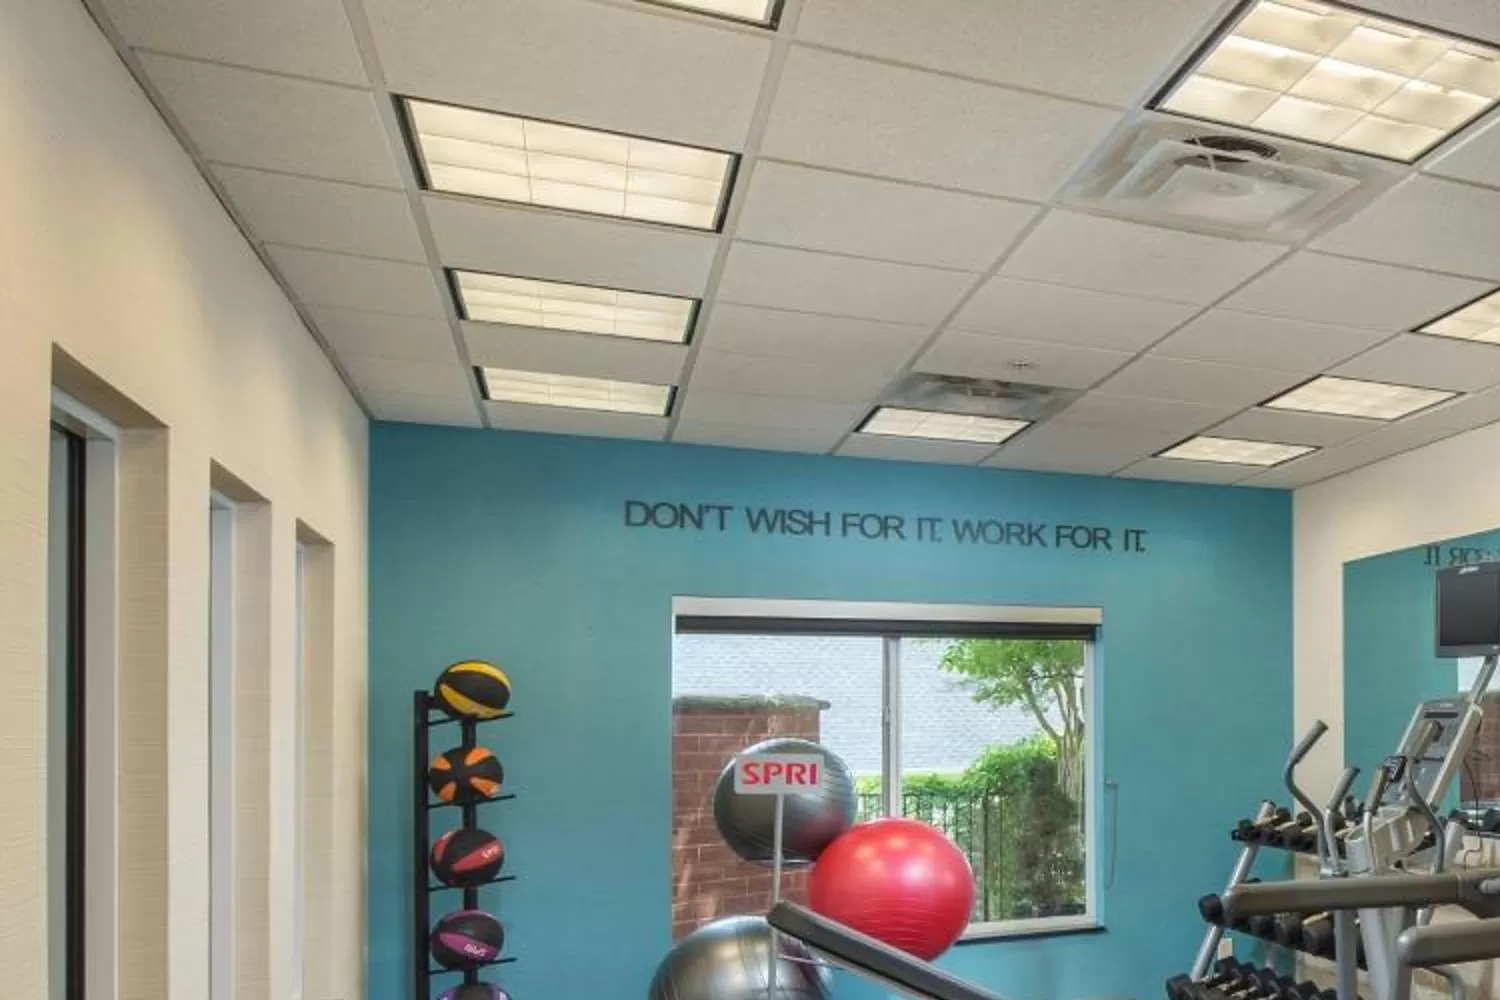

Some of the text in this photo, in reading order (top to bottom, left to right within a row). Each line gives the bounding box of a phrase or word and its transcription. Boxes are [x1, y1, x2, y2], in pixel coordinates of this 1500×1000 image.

[624, 500, 1147, 552] DON'T WISH FOR IT. WORK FOR IT.
[742, 762, 818, 785] SPRI
